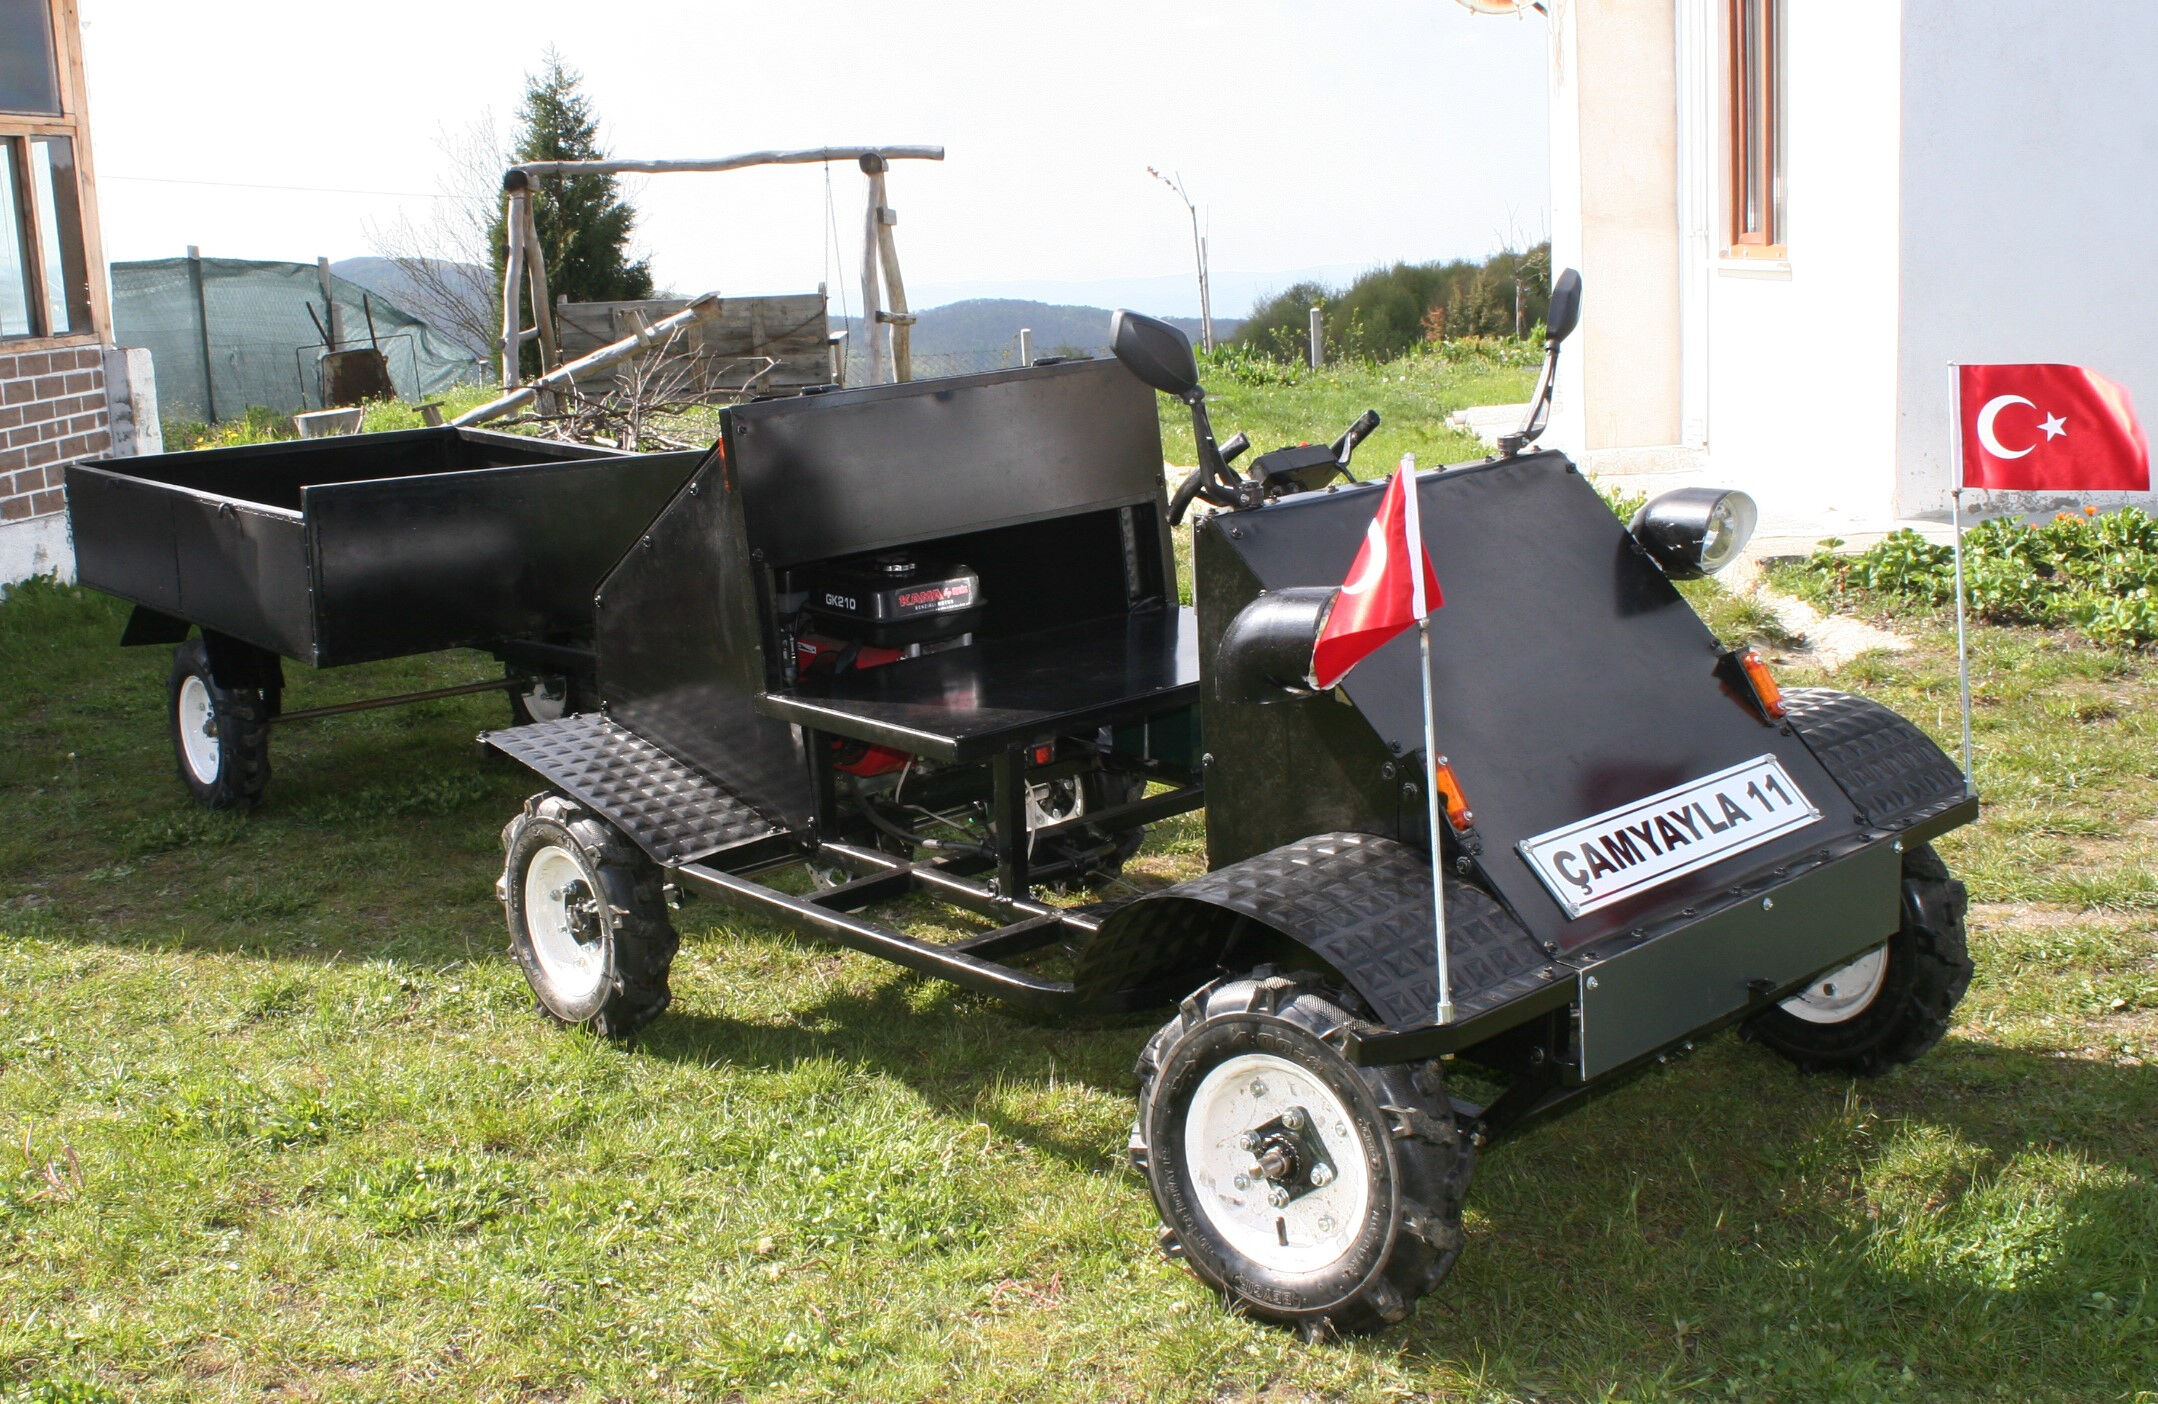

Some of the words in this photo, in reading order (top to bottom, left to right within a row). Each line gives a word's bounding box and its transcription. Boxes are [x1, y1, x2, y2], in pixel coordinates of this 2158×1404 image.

[825, 593, 856, 610] GK210
[899, 589, 943, 607] KAMA
[1552, 792, 1752, 895] ÇAMYAYLA
[1746, 774, 1793, 813] 11
